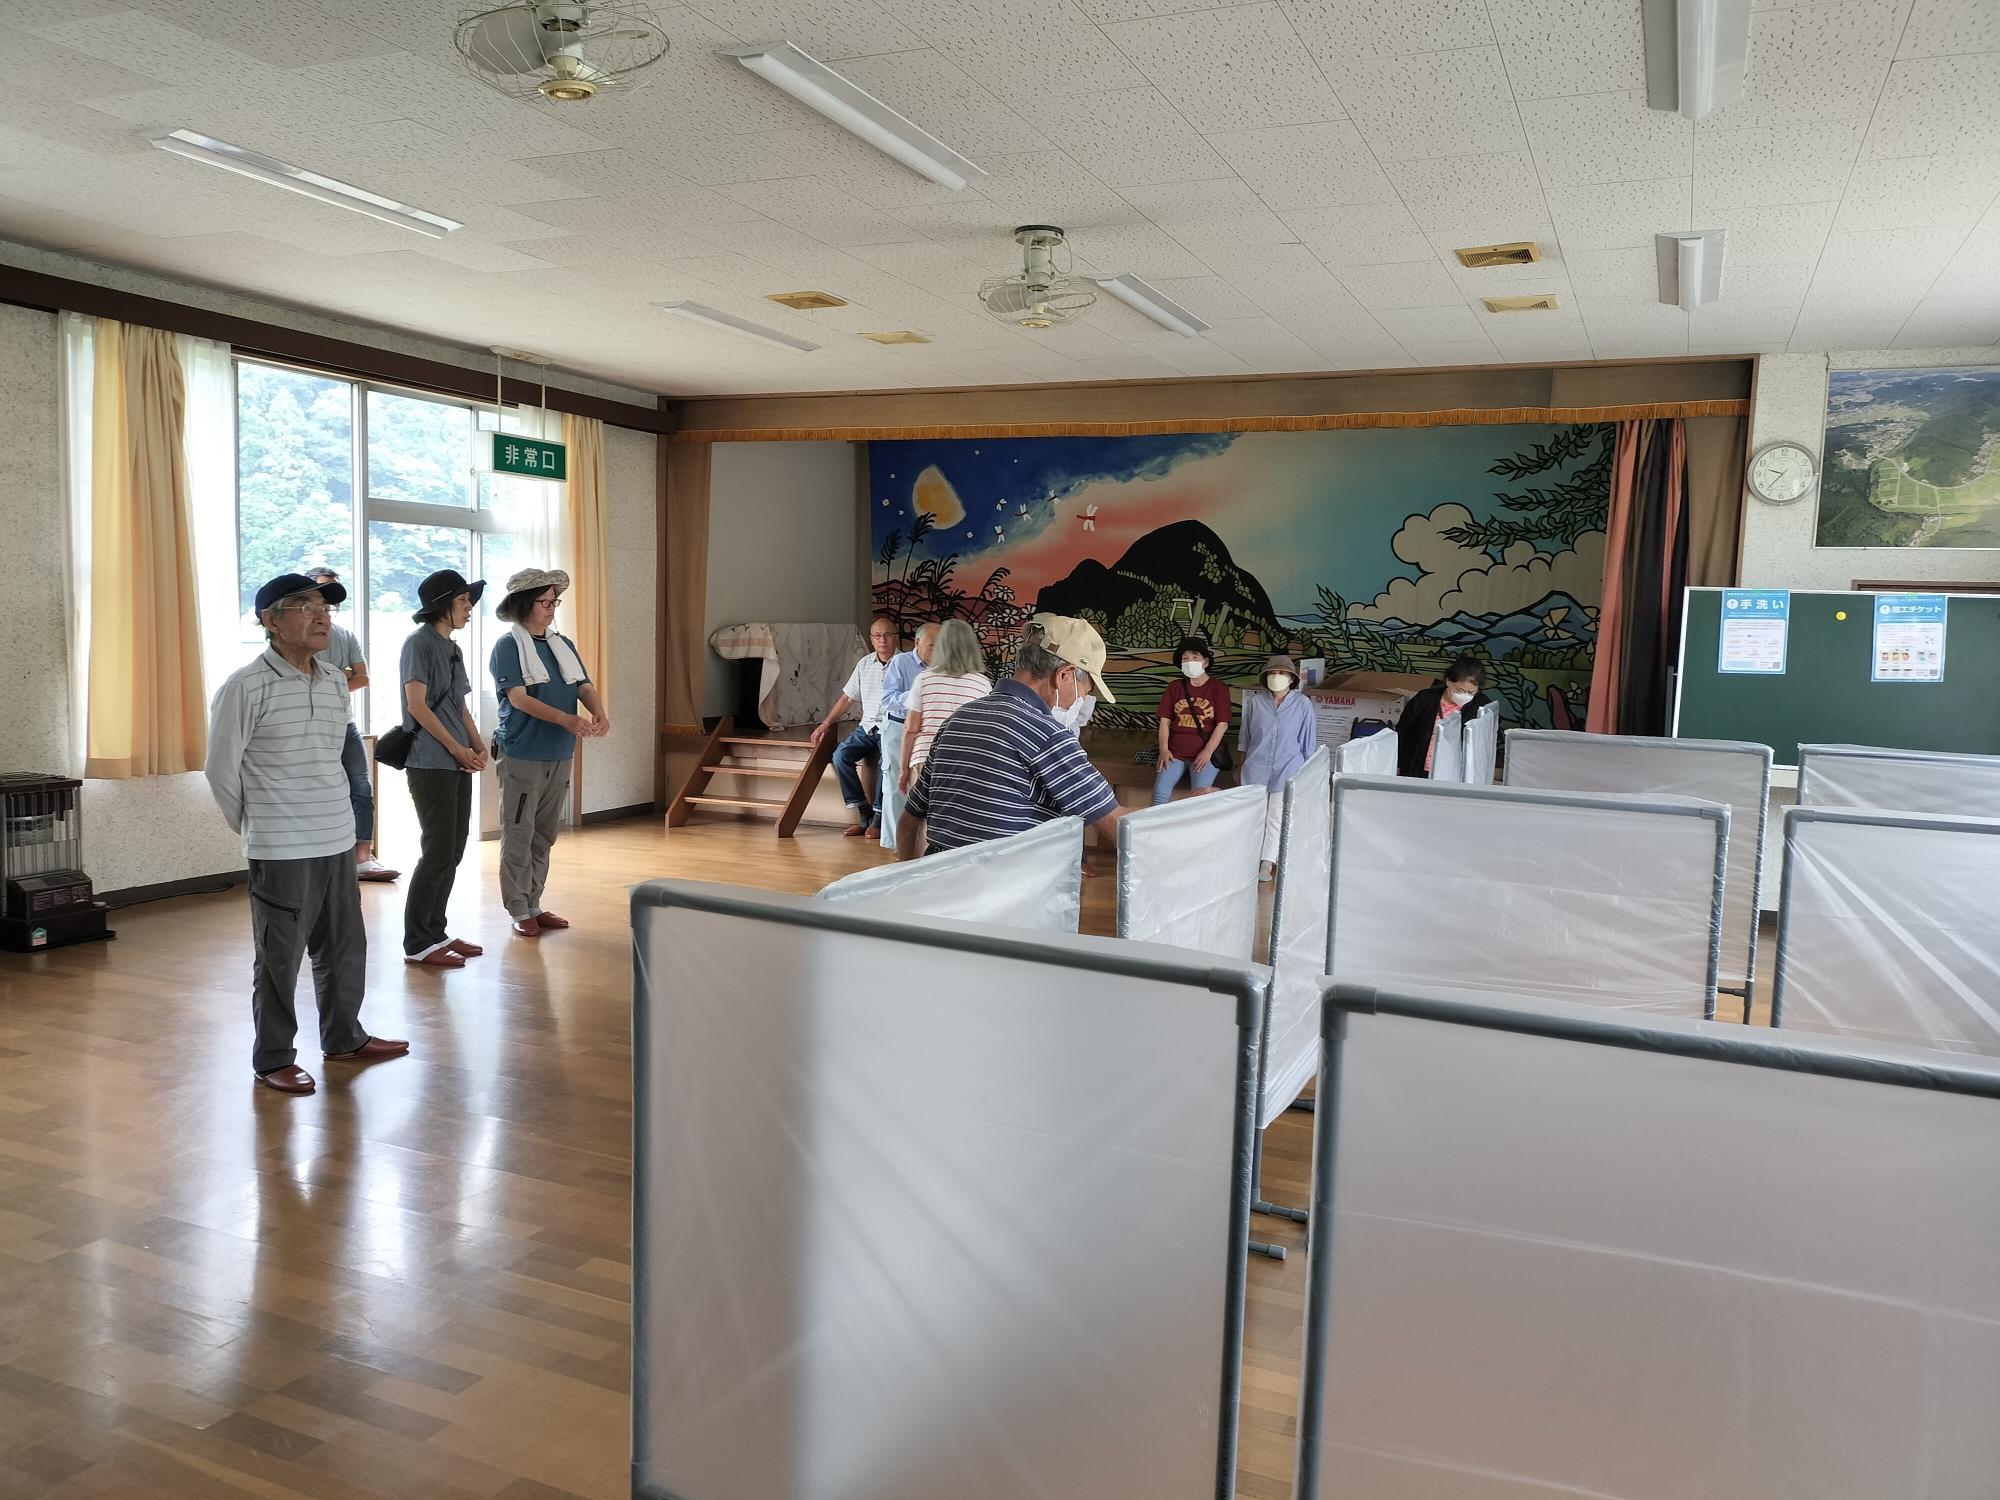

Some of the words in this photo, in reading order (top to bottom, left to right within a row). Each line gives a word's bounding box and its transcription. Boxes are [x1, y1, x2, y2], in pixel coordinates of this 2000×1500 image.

[504, 443, 555, 471] 非常口
[1739, 598, 1785, 610] 手洗い
[1322, 695, 1356, 706] YAMAHA
